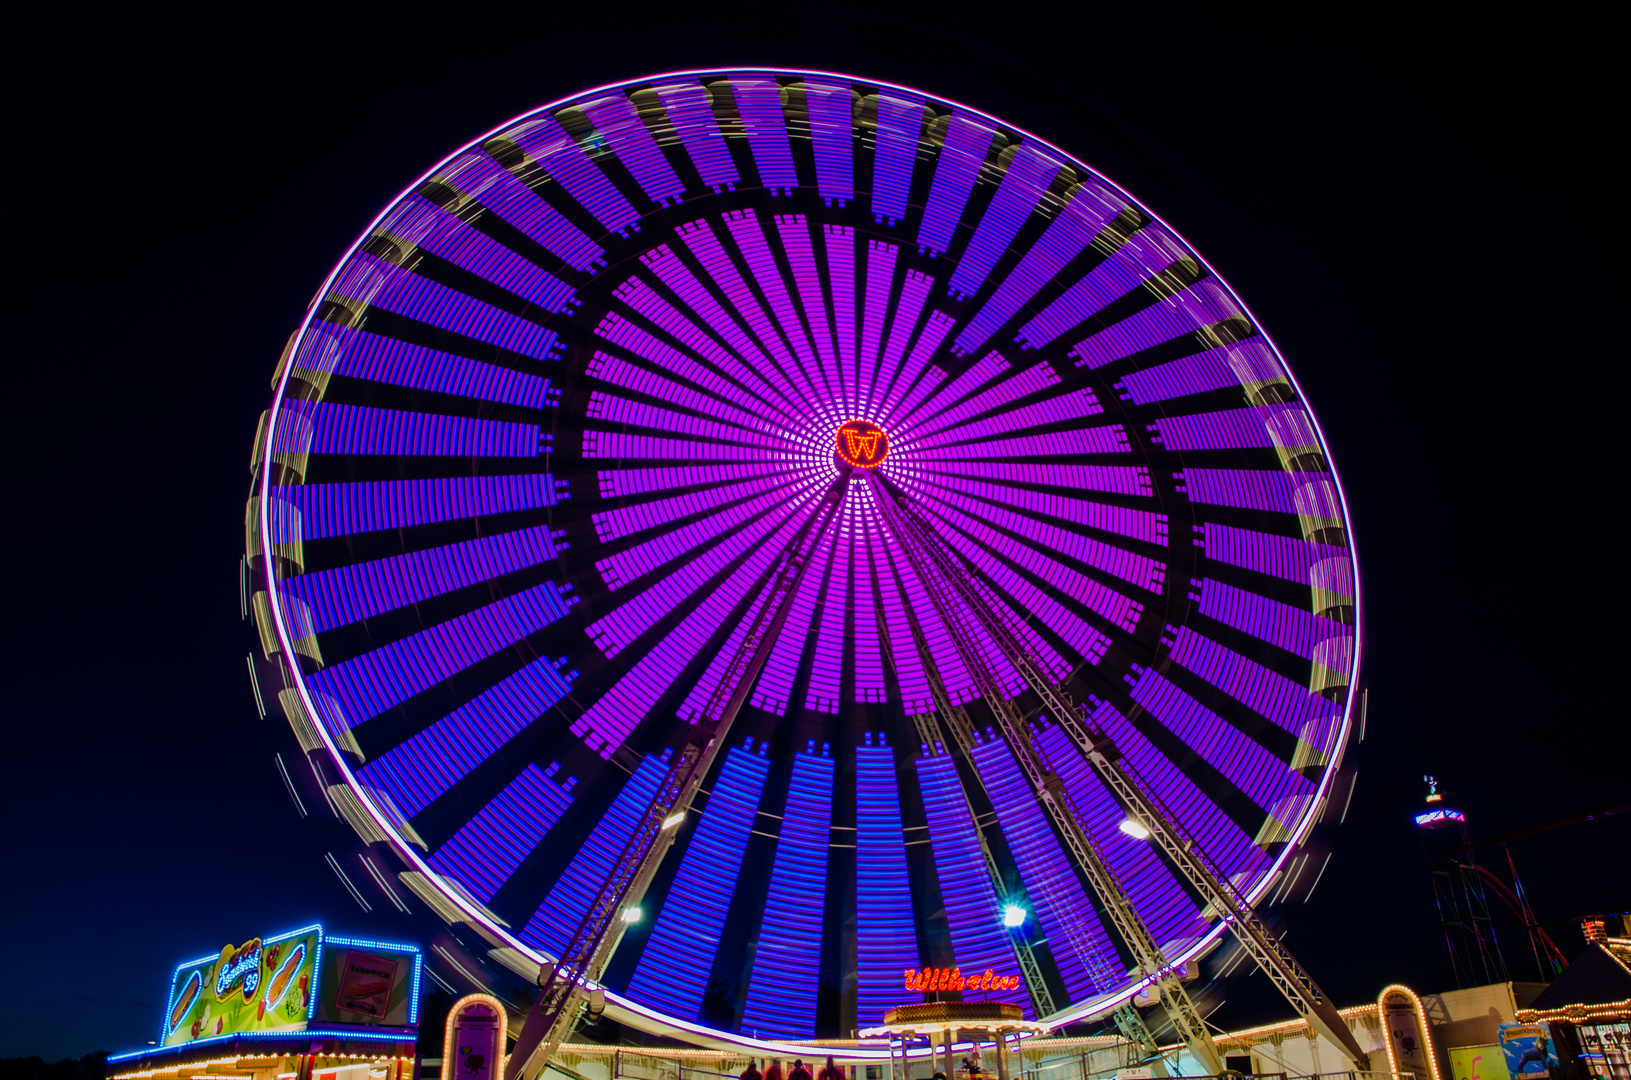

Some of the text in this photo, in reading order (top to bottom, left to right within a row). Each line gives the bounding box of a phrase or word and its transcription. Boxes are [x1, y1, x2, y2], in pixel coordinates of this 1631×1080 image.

[842, 428, 882, 461] W
[244, 972, 259, 992] 99
[351, 965, 390, 979] SANDWICH
[904, 967, 1019, 991] Wilhelm
[352, 1041, 389, 1051] SALATE
